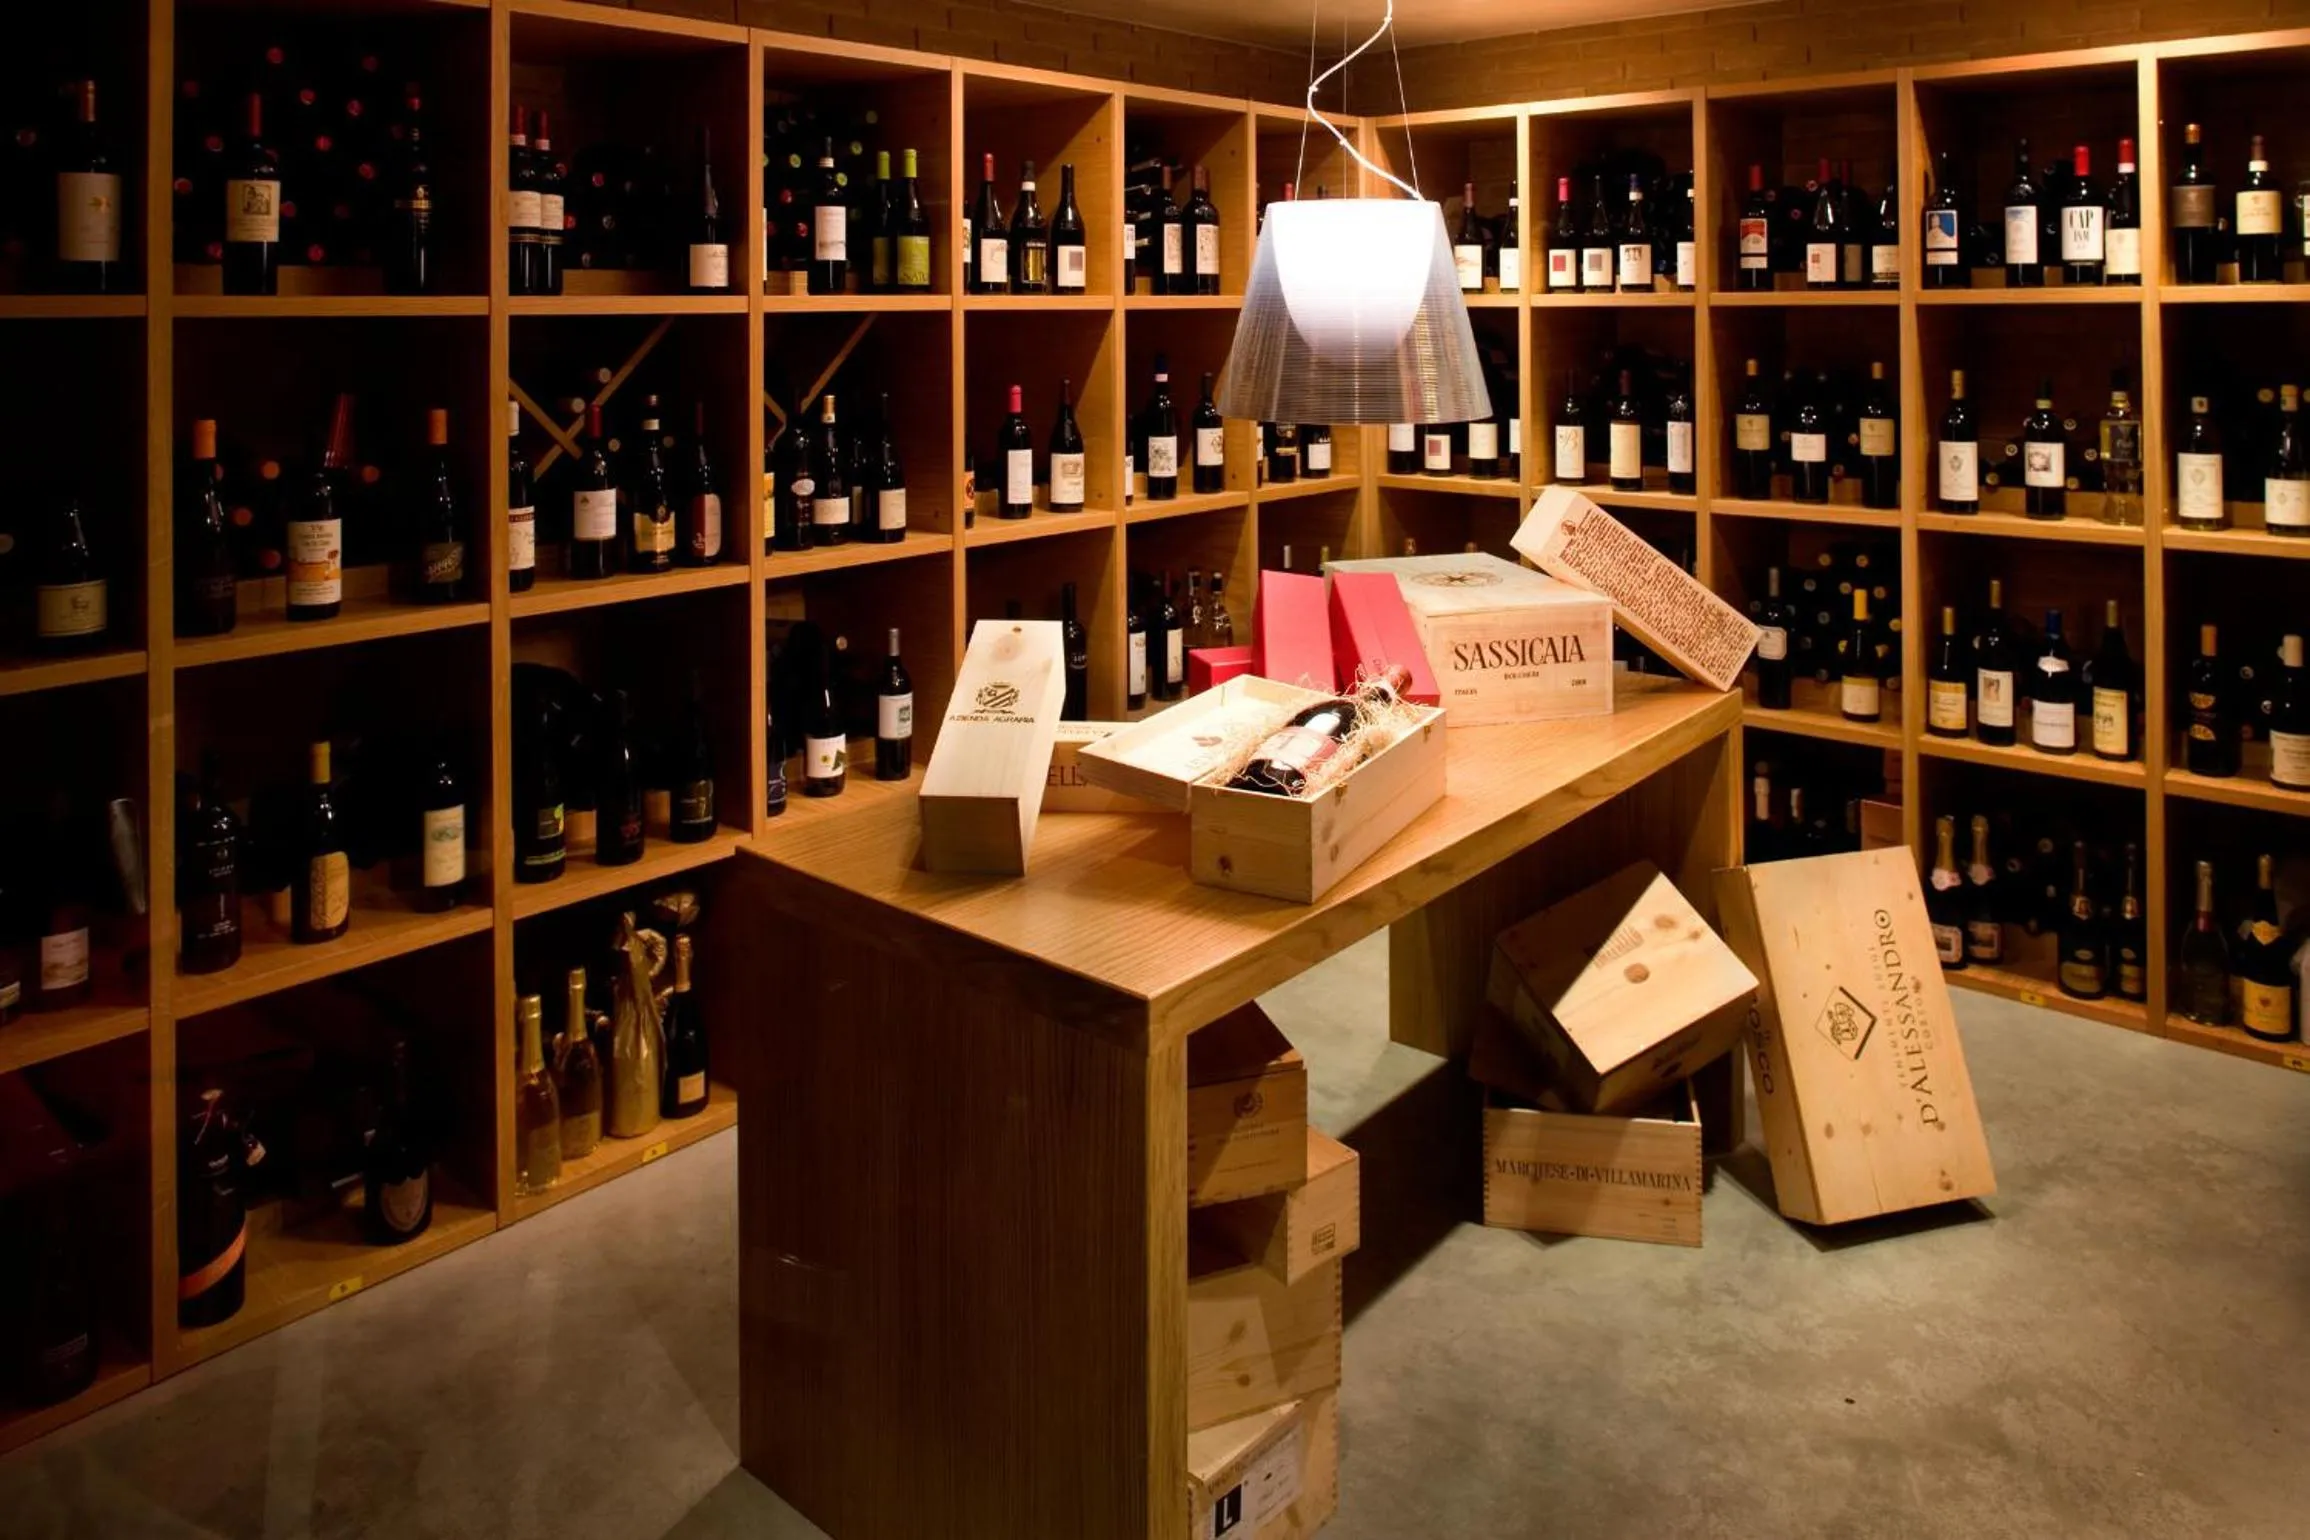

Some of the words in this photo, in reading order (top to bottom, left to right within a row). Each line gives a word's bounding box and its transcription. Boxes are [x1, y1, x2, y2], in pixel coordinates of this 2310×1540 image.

[1453, 634, 1586, 672] SASSICAIA
[949, 715, 990, 723] AZIENDA
[1047, 764, 1088, 787] ELL
[1872, 908, 1940, 1125] D'ALESSANDRO
[1222, 1496, 1233, 1529] L
